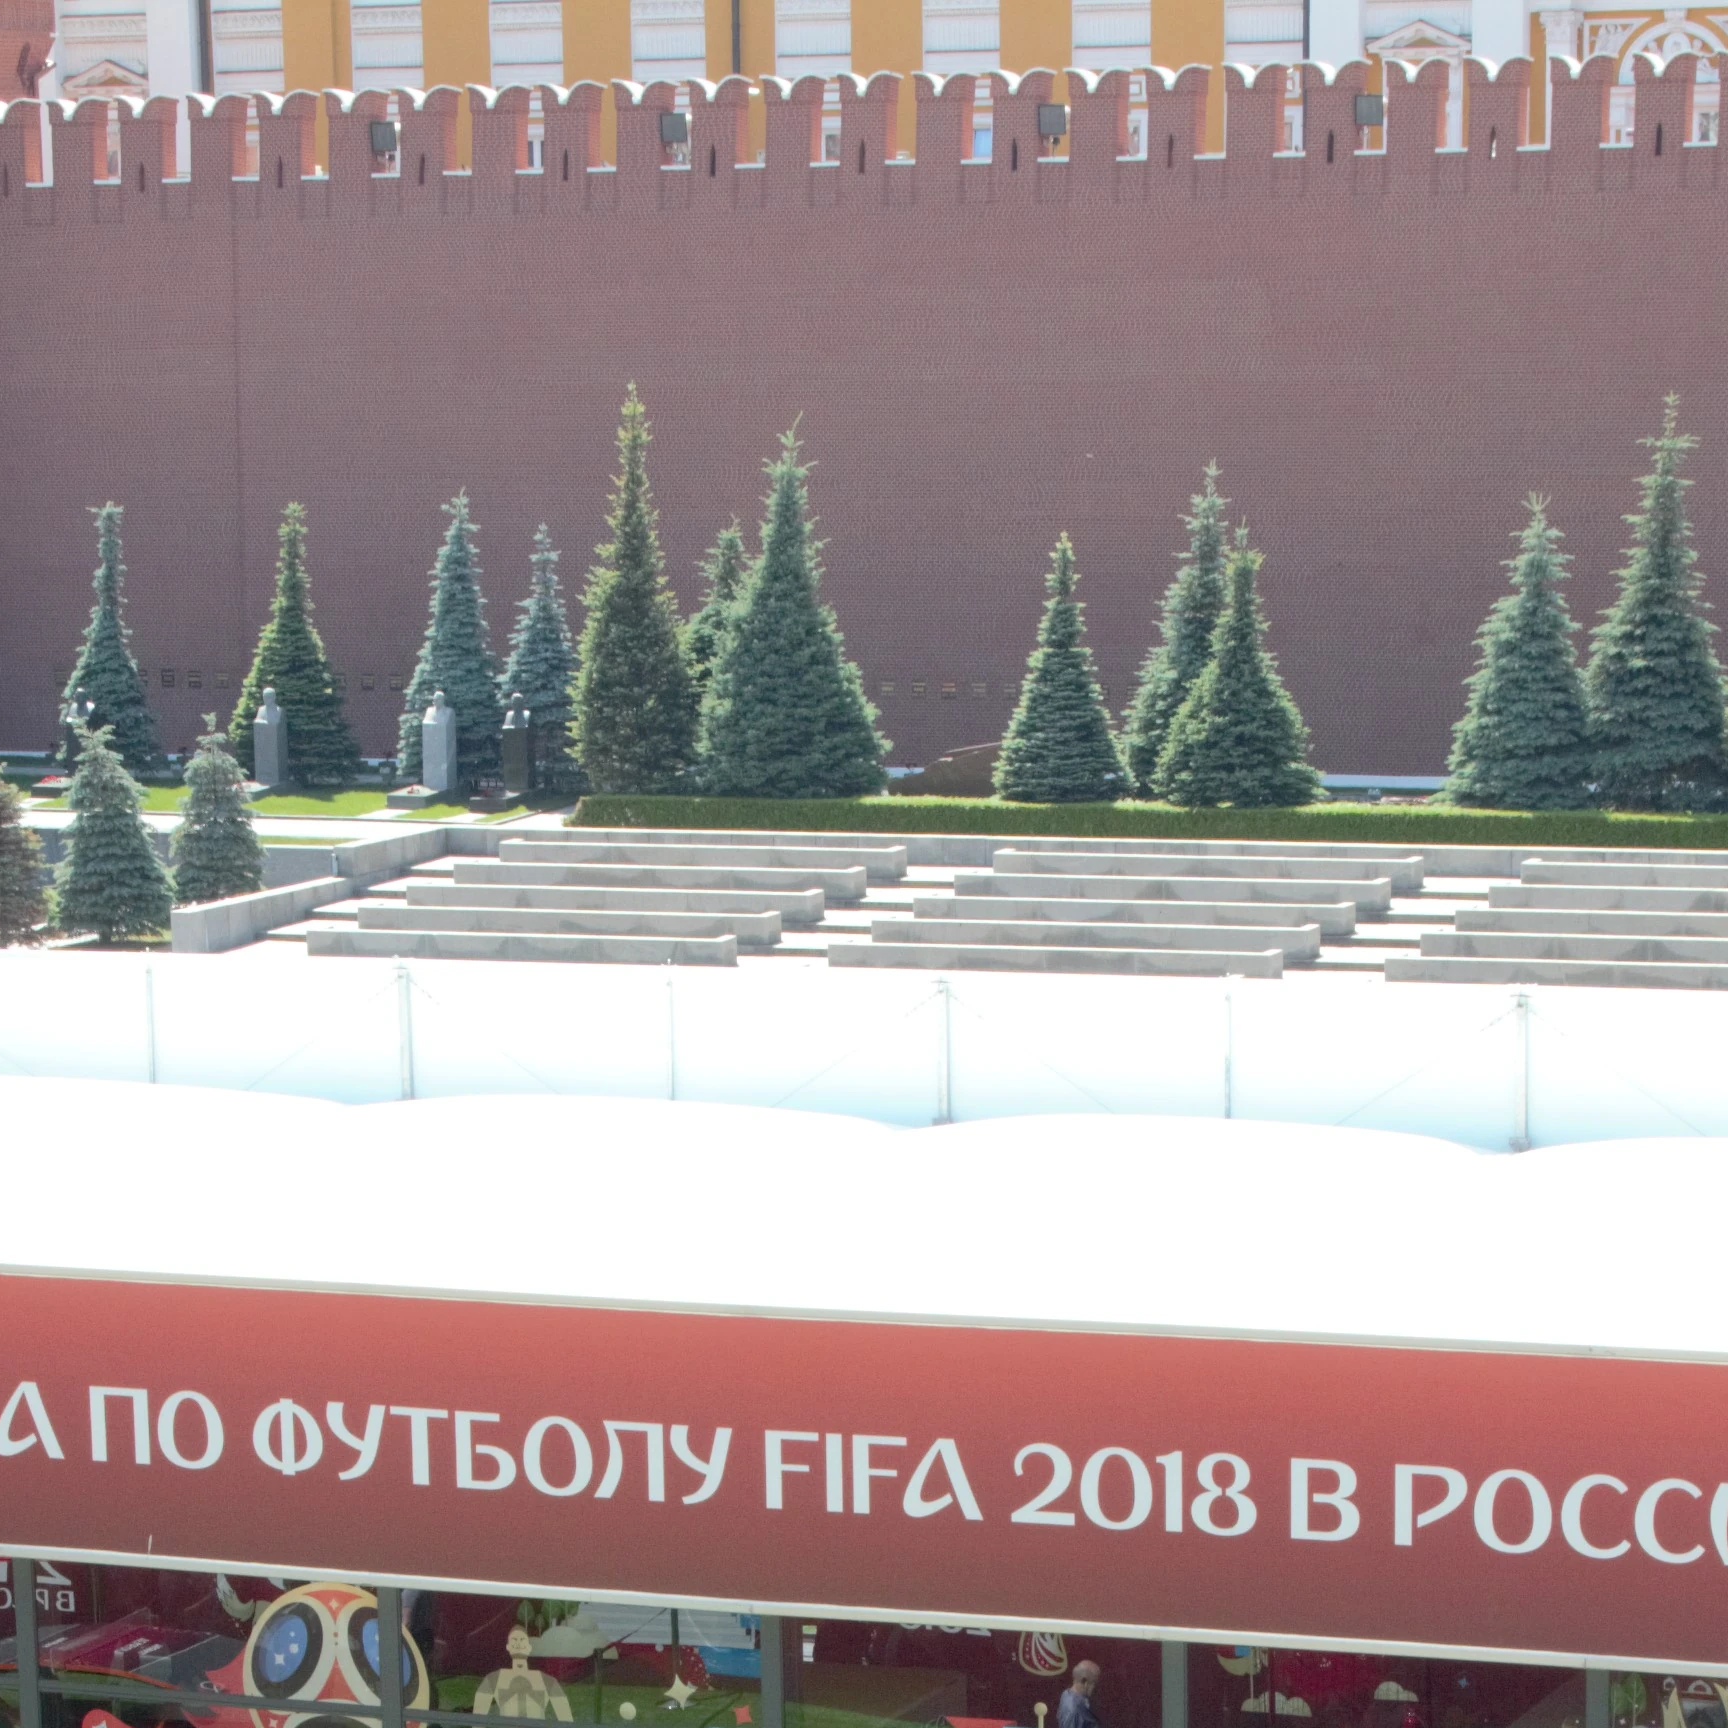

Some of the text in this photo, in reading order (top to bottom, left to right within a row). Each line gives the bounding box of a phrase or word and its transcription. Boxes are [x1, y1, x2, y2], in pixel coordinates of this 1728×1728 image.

[88, 1385, 225, 1470] ПО
[252, 1398, 733, 1507] ФУТБОЛУ
[764, 1429, 984, 1523] FIFA
[1010, 1442, 1258, 1537] 2018
[1289, 1457, 1361, 1543] В
